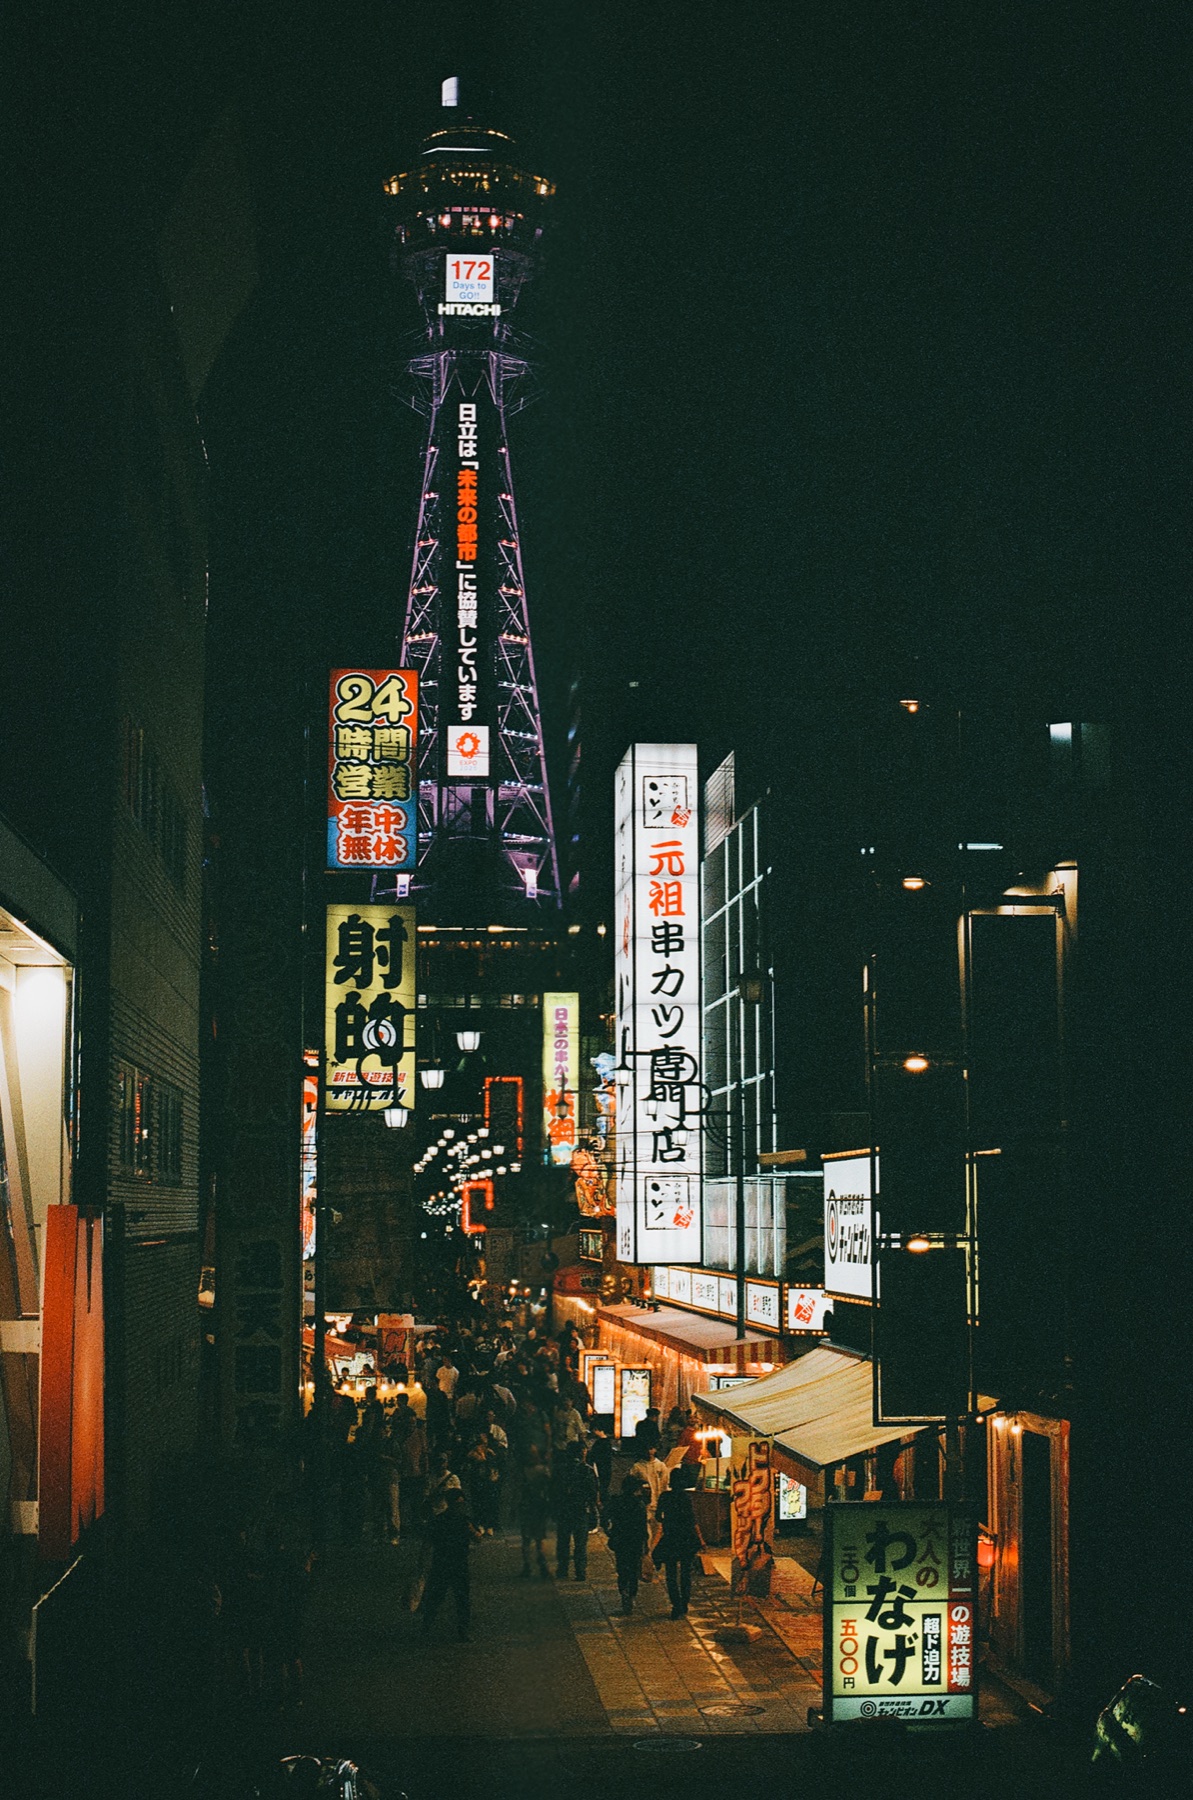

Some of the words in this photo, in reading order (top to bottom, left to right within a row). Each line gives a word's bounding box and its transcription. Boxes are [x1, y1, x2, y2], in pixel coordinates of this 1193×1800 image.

[451, 261, 491, 280] 172
[453, 281, 474, 291] Days
[477, 281, 487, 290] to
[438, 303, 501, 316] HITACHI
[459, 291, 480, 300] GO!!
[335, 674, 411, 724] 24
[335, 725, 409, 761] 時間
[334, 763, 410, 799] 営業
[342, 806, 404, 834] 年中
[342, 835, 404, 861] 無休
[333, 913, 408, 1067] 射的
[915, 1518, 942, 1588] 大人の
[864, 1520, 919, 1687] わなげ
[923, 1617, 940, 1682] 超ド迫力
[918, 1699, 950, 1716] DX
